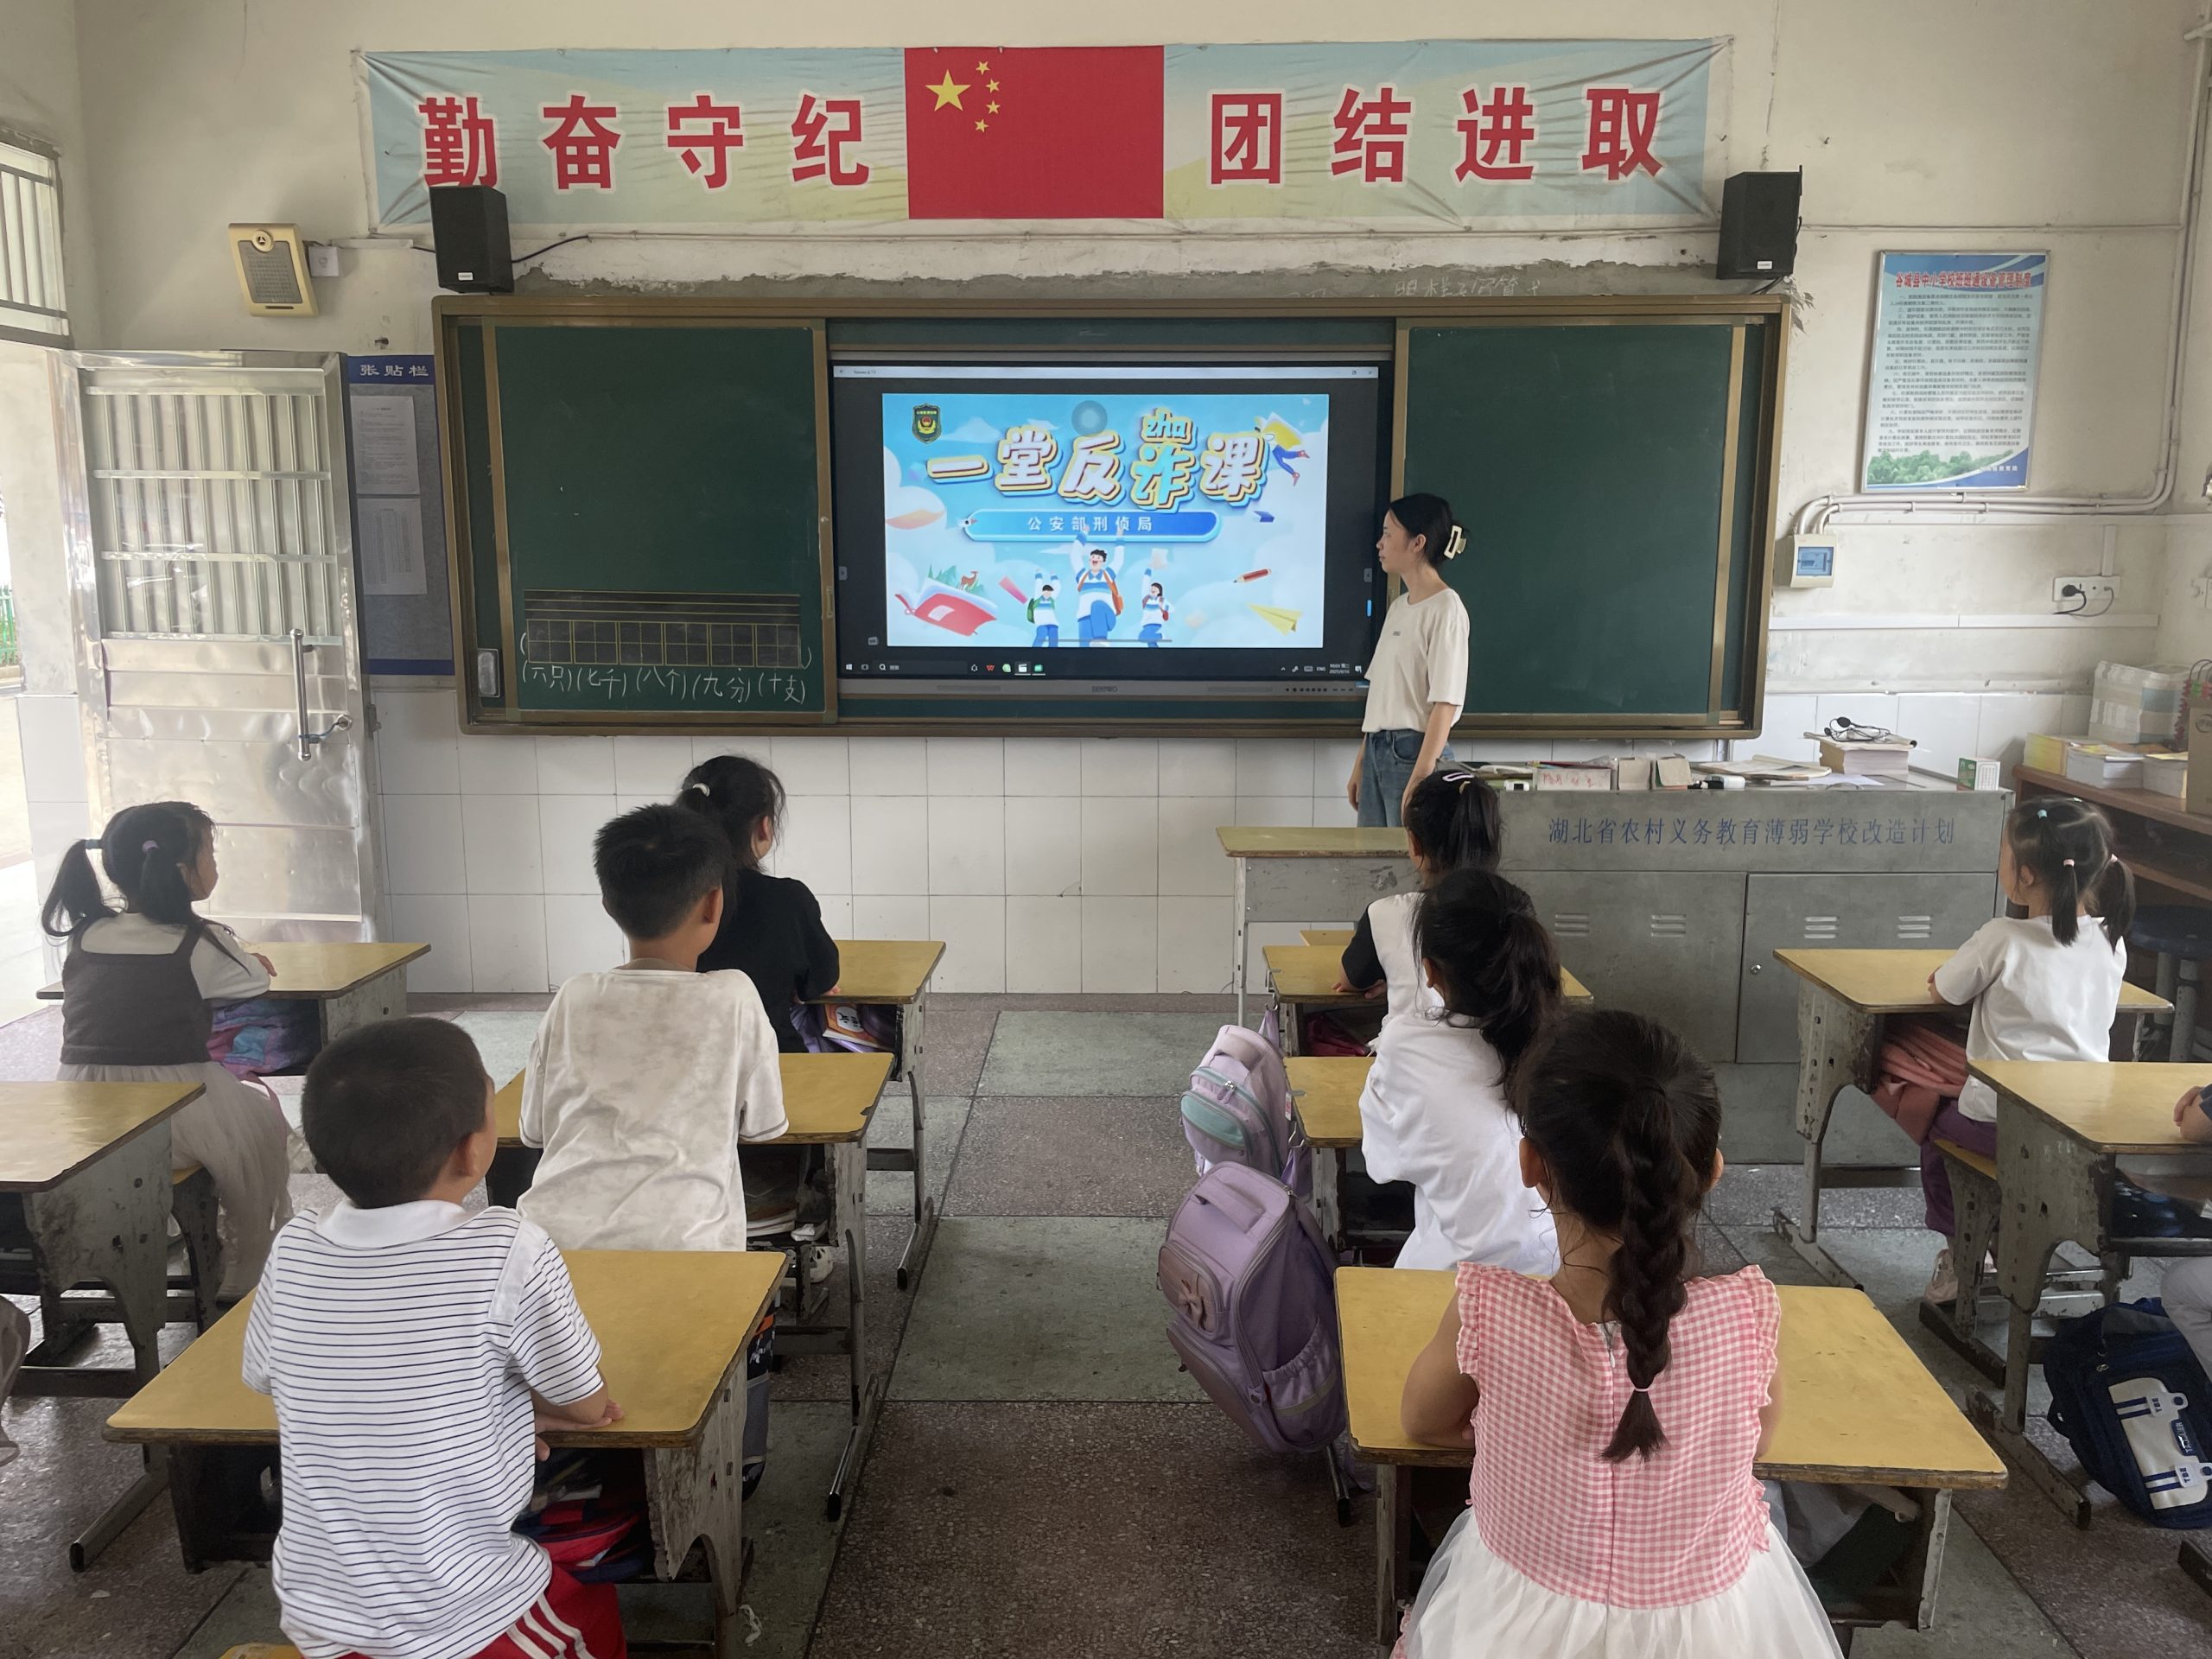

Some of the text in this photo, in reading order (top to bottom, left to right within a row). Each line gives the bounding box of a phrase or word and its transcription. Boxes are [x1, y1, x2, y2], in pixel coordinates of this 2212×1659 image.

[418, 86, 1664, 190] 勤奋守纪 团结进取
[359, 364, 429, 377] 张贴栏
[1145, 410, 1190, 440] zha
[928, 425, 1266, 511] 一堂反诈课
[1027, 516, 1154, 532] 公安部刑侦局
[1549, 817, 1955, 846] 湖北省农村义务教育薄弱学校改造计划
